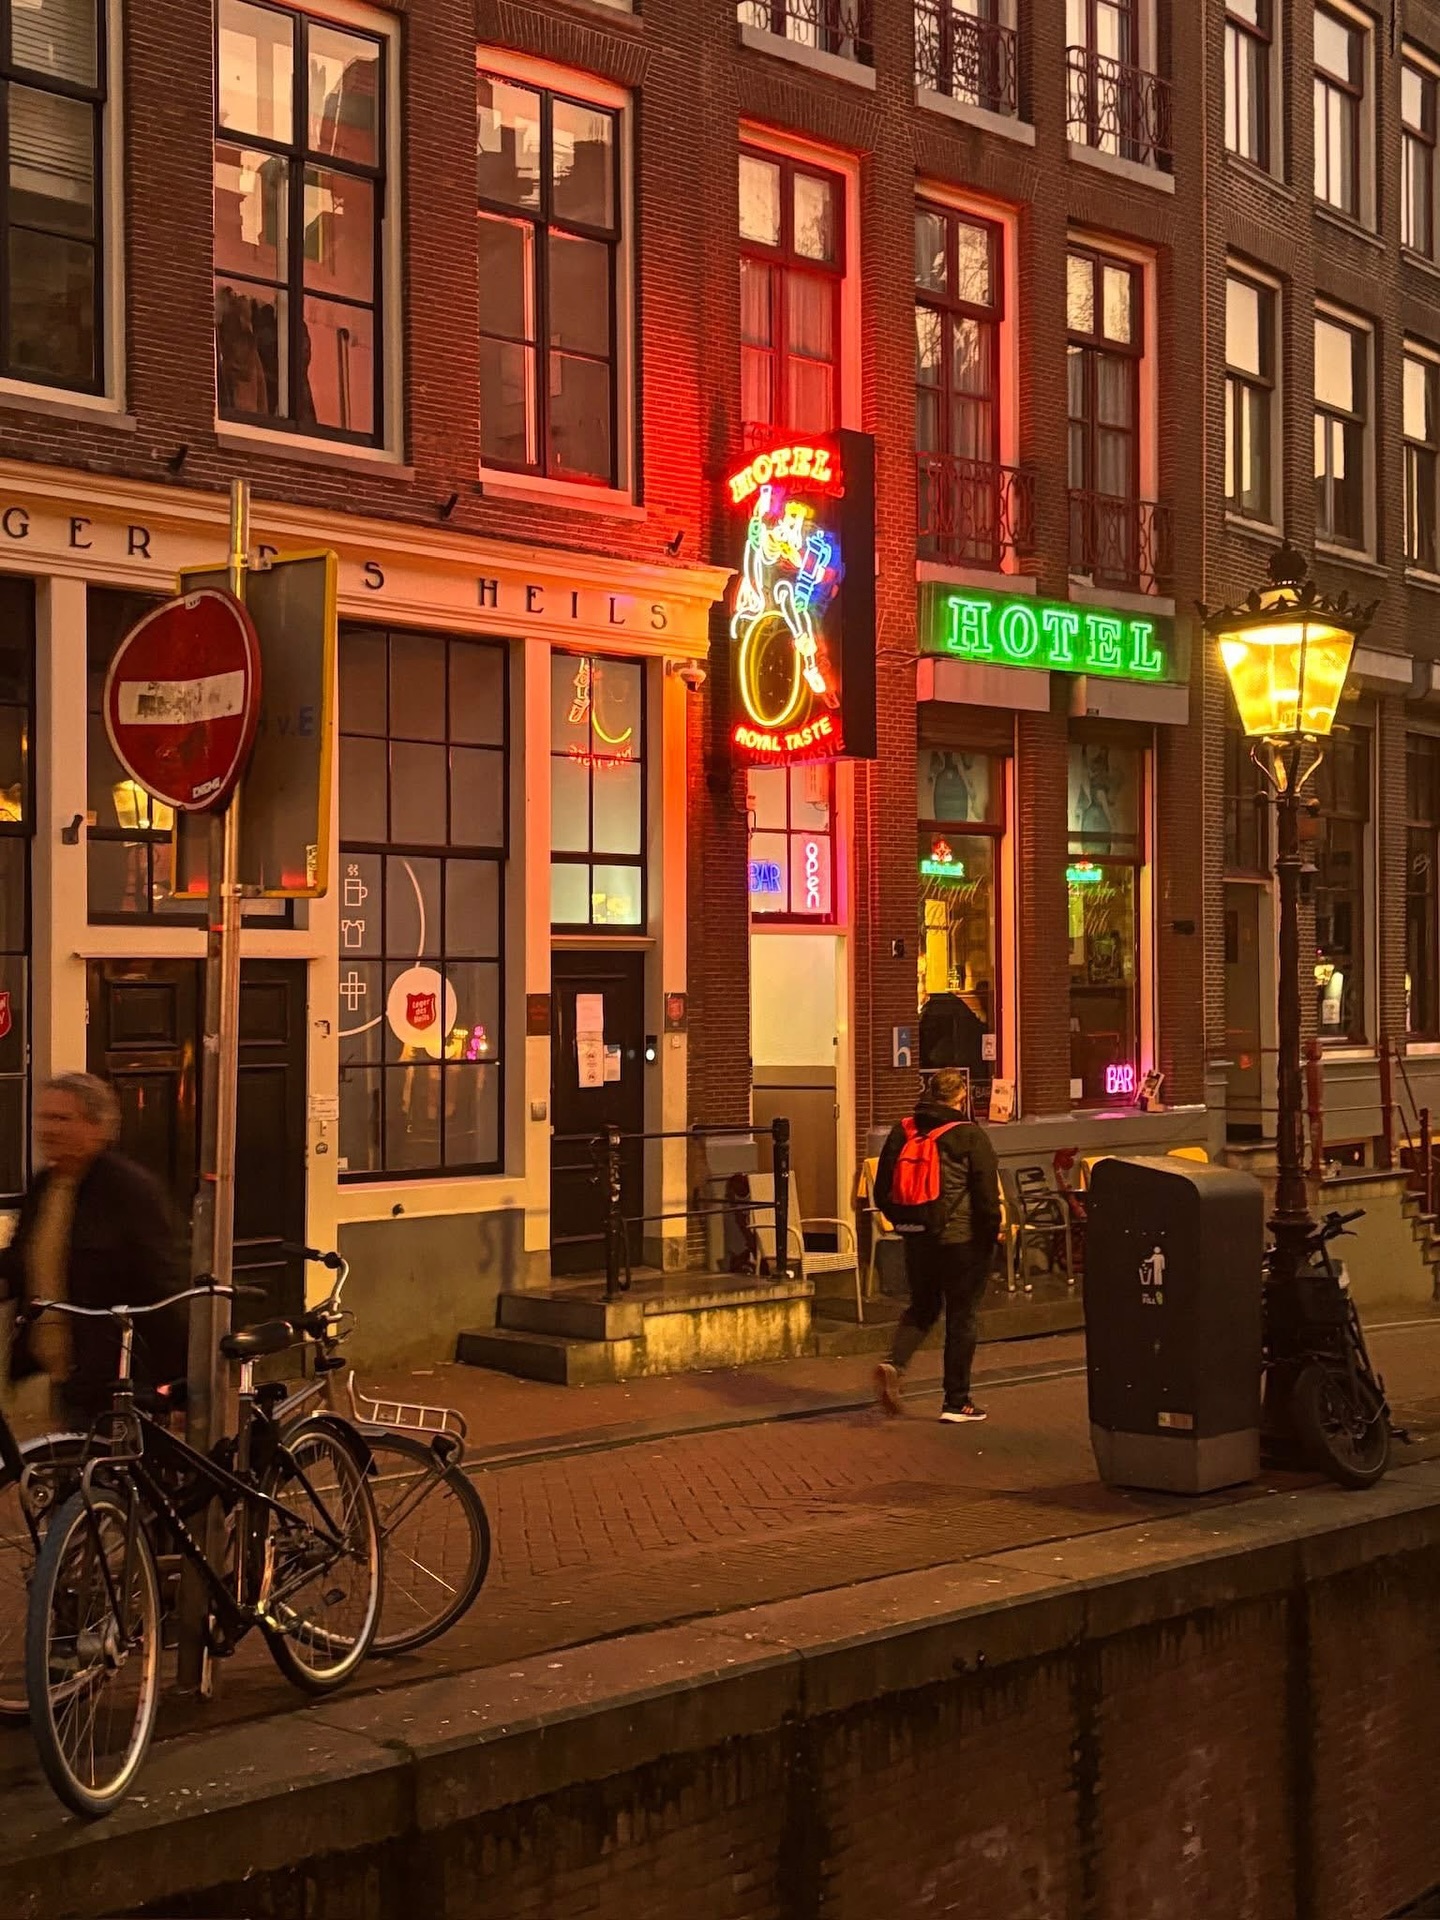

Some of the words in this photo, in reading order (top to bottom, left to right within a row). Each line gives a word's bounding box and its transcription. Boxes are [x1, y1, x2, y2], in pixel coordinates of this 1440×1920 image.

[729, 446, 832, 503] HOTEL
[479, 578, 668, 629] HEILS
[948, 597, 1162, 672] HOTEL
[735, 727, 781, 751] ROYAL
[785, 716, 833, 750] TASTE
[750, 862, 782, 893] BAR
[1106, 1064, 1134, 1094] BAR
